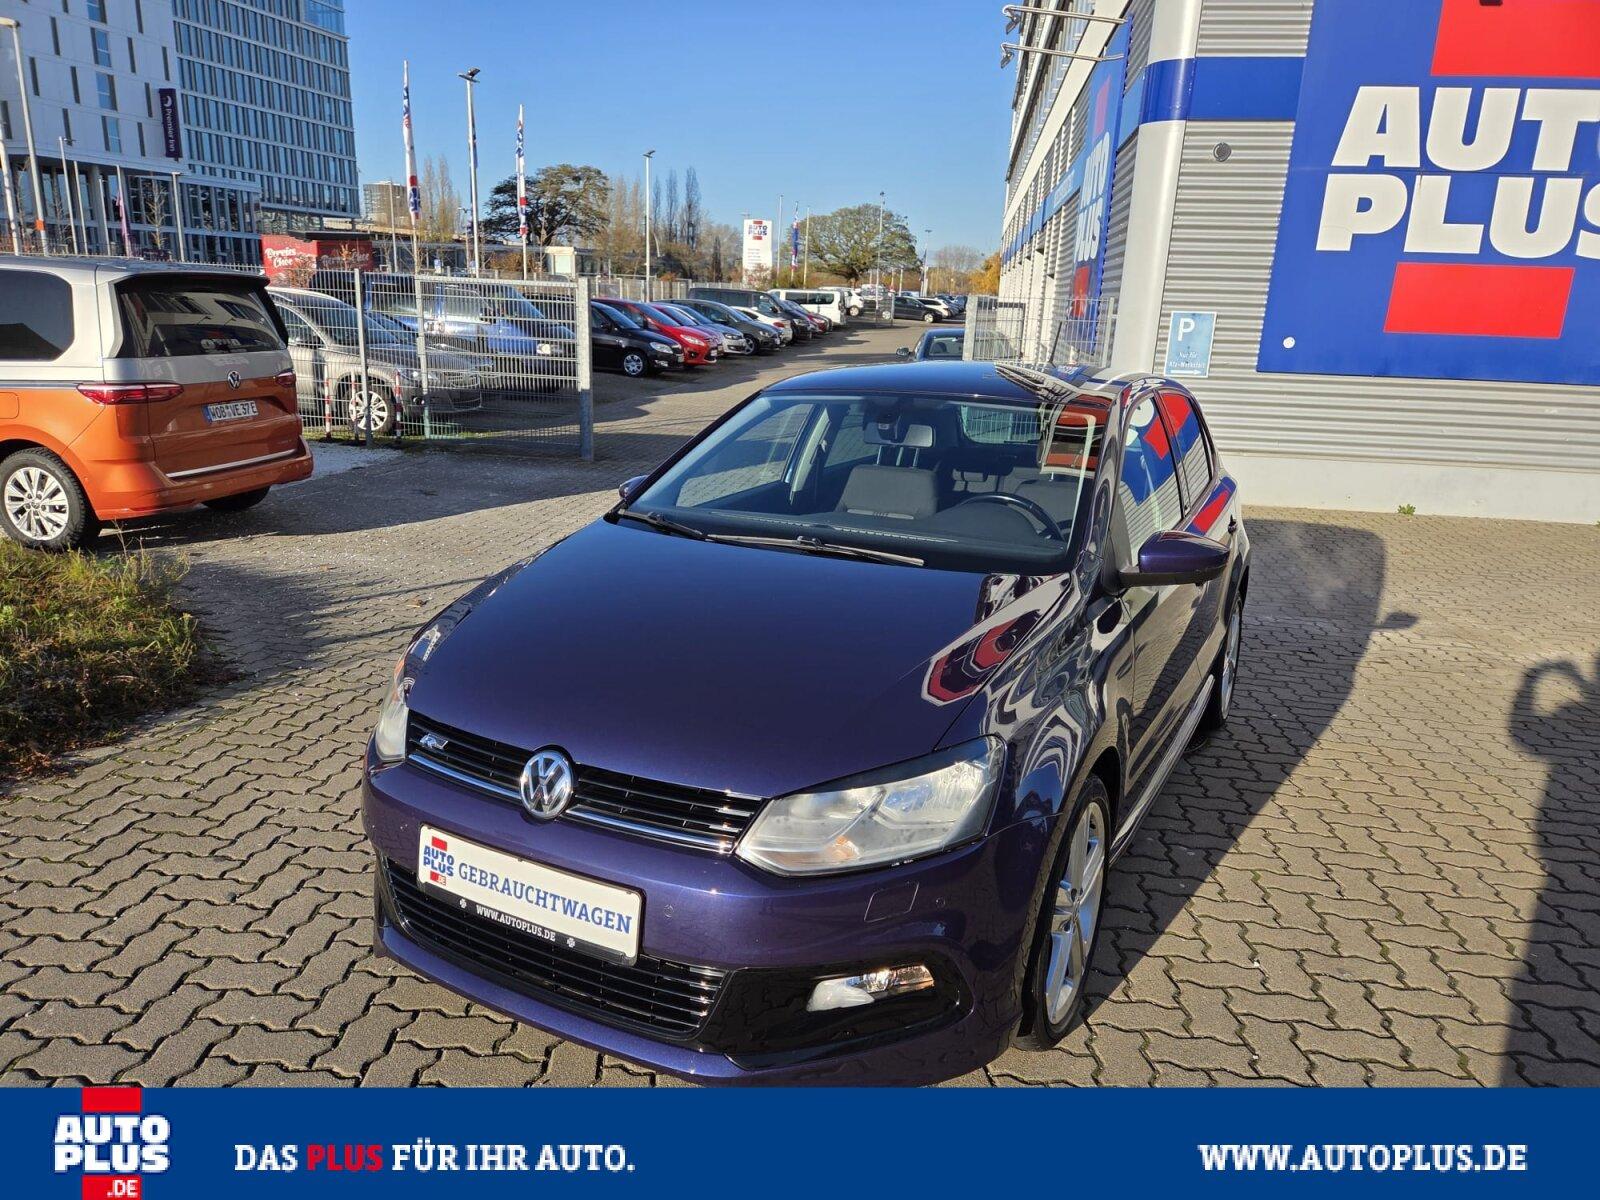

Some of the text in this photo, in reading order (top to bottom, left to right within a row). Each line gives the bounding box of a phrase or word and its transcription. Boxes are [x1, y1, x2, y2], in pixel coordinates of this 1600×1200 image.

[165, 108, 174, 138] Premier
[1330, 86, 1600, 172] AUT
[1178, 317, 1196, 341] P
[423, 845, 455, 866] AUTO
[423, 855, 454, 877] PLUS
[459, 863, 632, 934] GEBRAUCHTWAGEN
[476, 904, 556, 942] WWW.AUTOPLUS.DE
